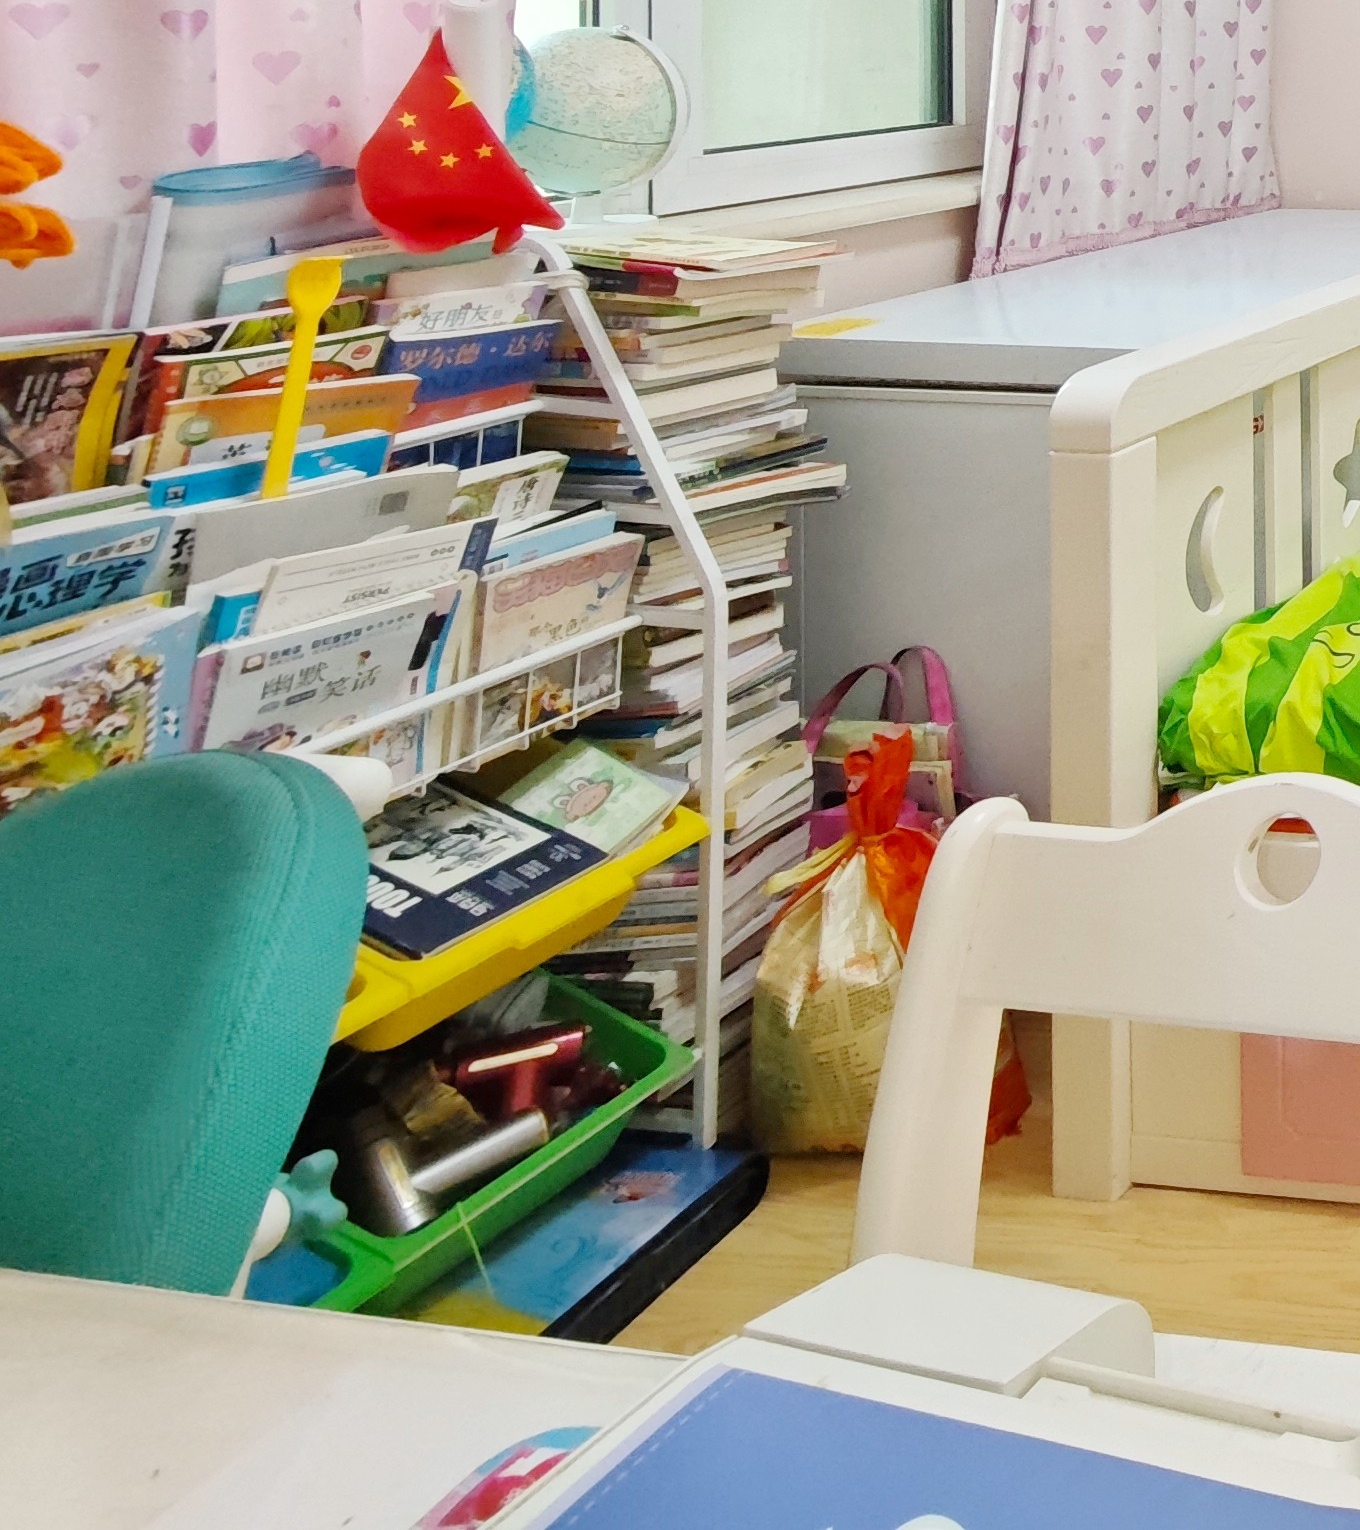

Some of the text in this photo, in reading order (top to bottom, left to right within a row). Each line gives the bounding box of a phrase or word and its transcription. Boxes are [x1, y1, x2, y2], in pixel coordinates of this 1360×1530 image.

[418, 303, 488, 334] 好朋友
[0, 557, 147, 622] 心理学
